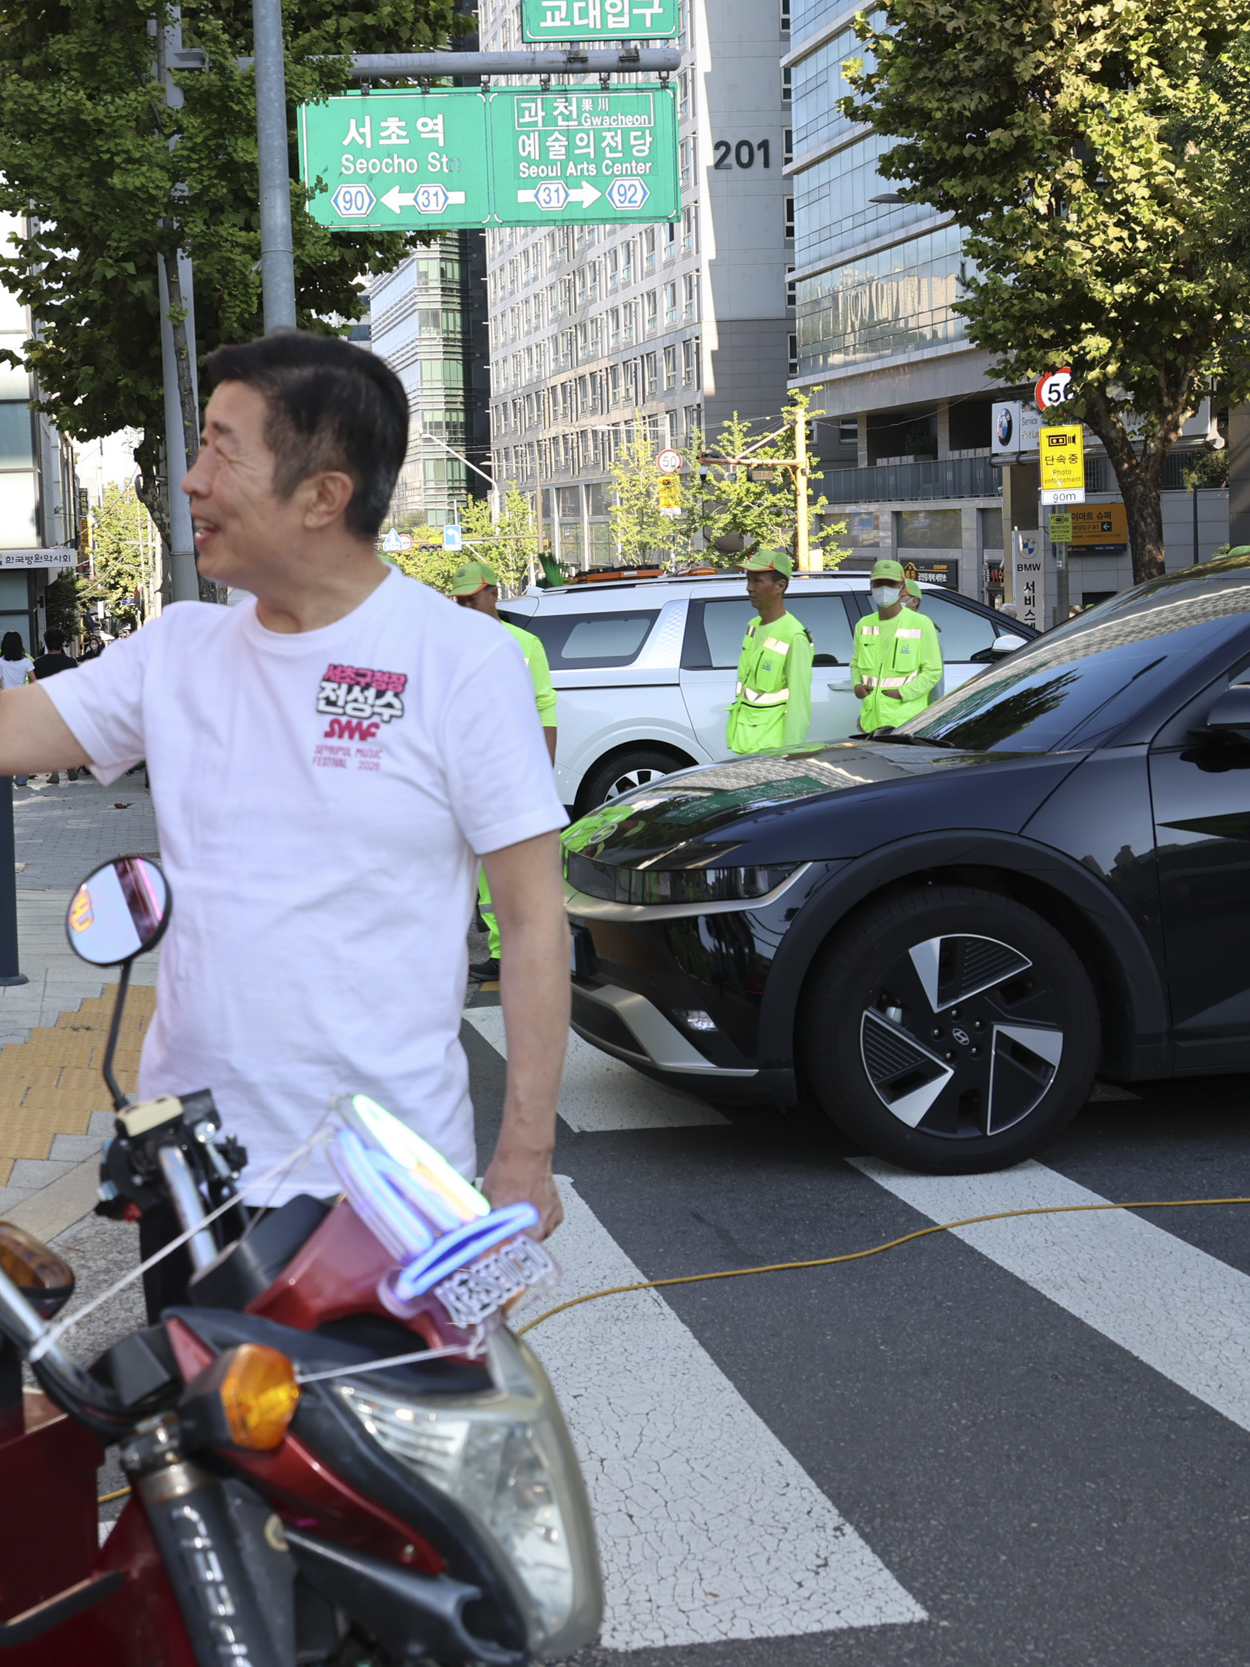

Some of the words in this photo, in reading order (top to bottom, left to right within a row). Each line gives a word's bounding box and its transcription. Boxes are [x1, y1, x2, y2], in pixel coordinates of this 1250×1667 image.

[539, 0, 664, 29] 교대입구
[519, 97, 579, 128] 과천
[581, 97, 609, 112] 果川
[581, 112, 649, 126] Gwacheon
[341, 113, 445, 149] 서초역
[518, 129, 653, 160] 예술의전당
[713, 138, 770, 170] 201
[341, 153, 418, 175] Seocho
[427, 151, 461, 173] Stn
[519, 161, 561, 178] Seoul
[566, 161, 597, 176] Arts
[602, 159, 652, 175] Center
[342, 190, 365, 211] 90
[421, 190, 440, 208] 31
[542, 186, 560, 205] 31
[617, 183, 638, 204] 92
[662, 455, 677, 468] 50
[1045, 453, 1078, 466] 단속중
[1053, 493, 1076, 503] 90m
[1071, 512, 1094, 521] 이마트
[1096, 511, 1112, 520] 슈퍼
[5, 553, 71, 565] 한국병원약사회
[1017, 563, 1041, 572] BMW
[323, 663, 408, 694] 서초구청장
[317, 680, 404, 723] 전성수
[312, 756, 348, 769] FESTIVAL
[355, 747, 383, 760] MUSIC
